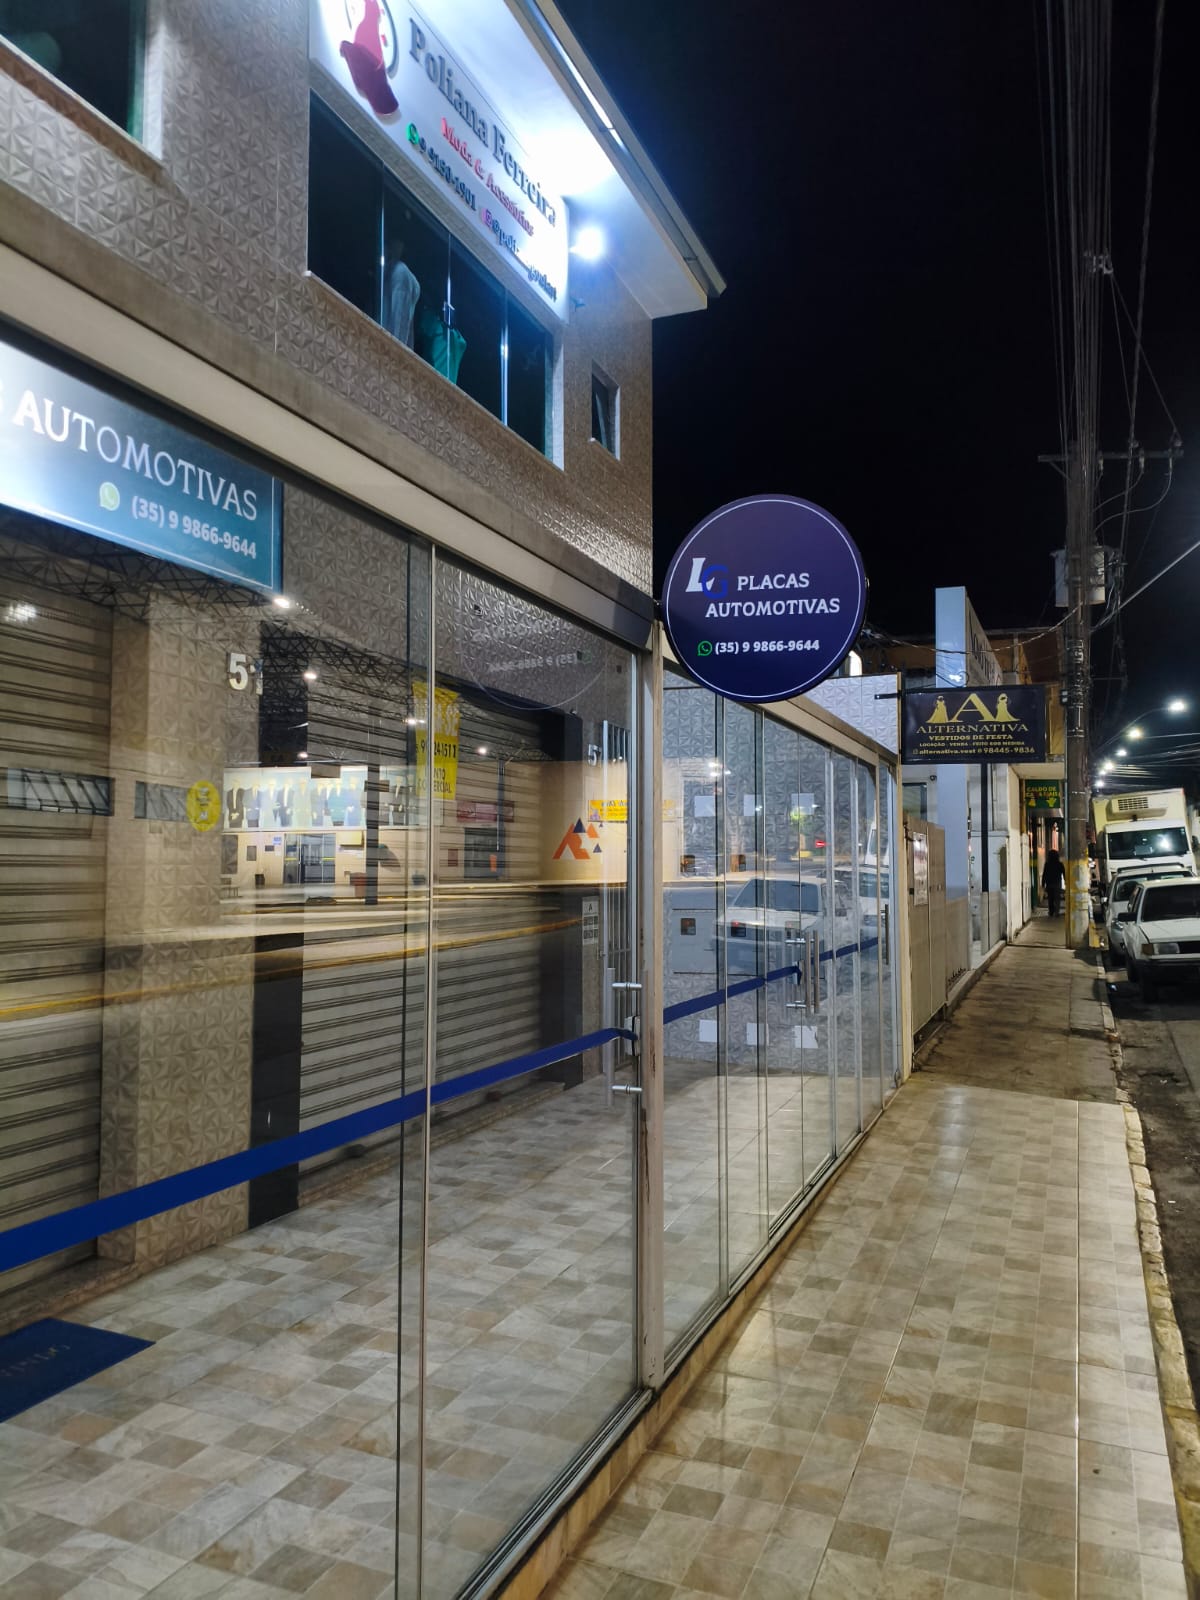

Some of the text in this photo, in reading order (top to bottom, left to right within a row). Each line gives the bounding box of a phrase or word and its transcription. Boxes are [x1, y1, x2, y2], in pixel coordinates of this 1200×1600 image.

[409, 18, 488, 147] Poliana
[493, 123, 556, 228] Ferreira
[12, 389, 257, 521] AUTOMOTIVAS
[132, 495, 257, 559] (35) 9 9866-9644
[737, 572, 810, 591] PLACAS
[705, 597, 840, 618] AUTOMOTIVAS
[715, 639, 820, 655] (35) 9 9866-9644
[916, 723, 1029, 734] ALTERNATIVA
